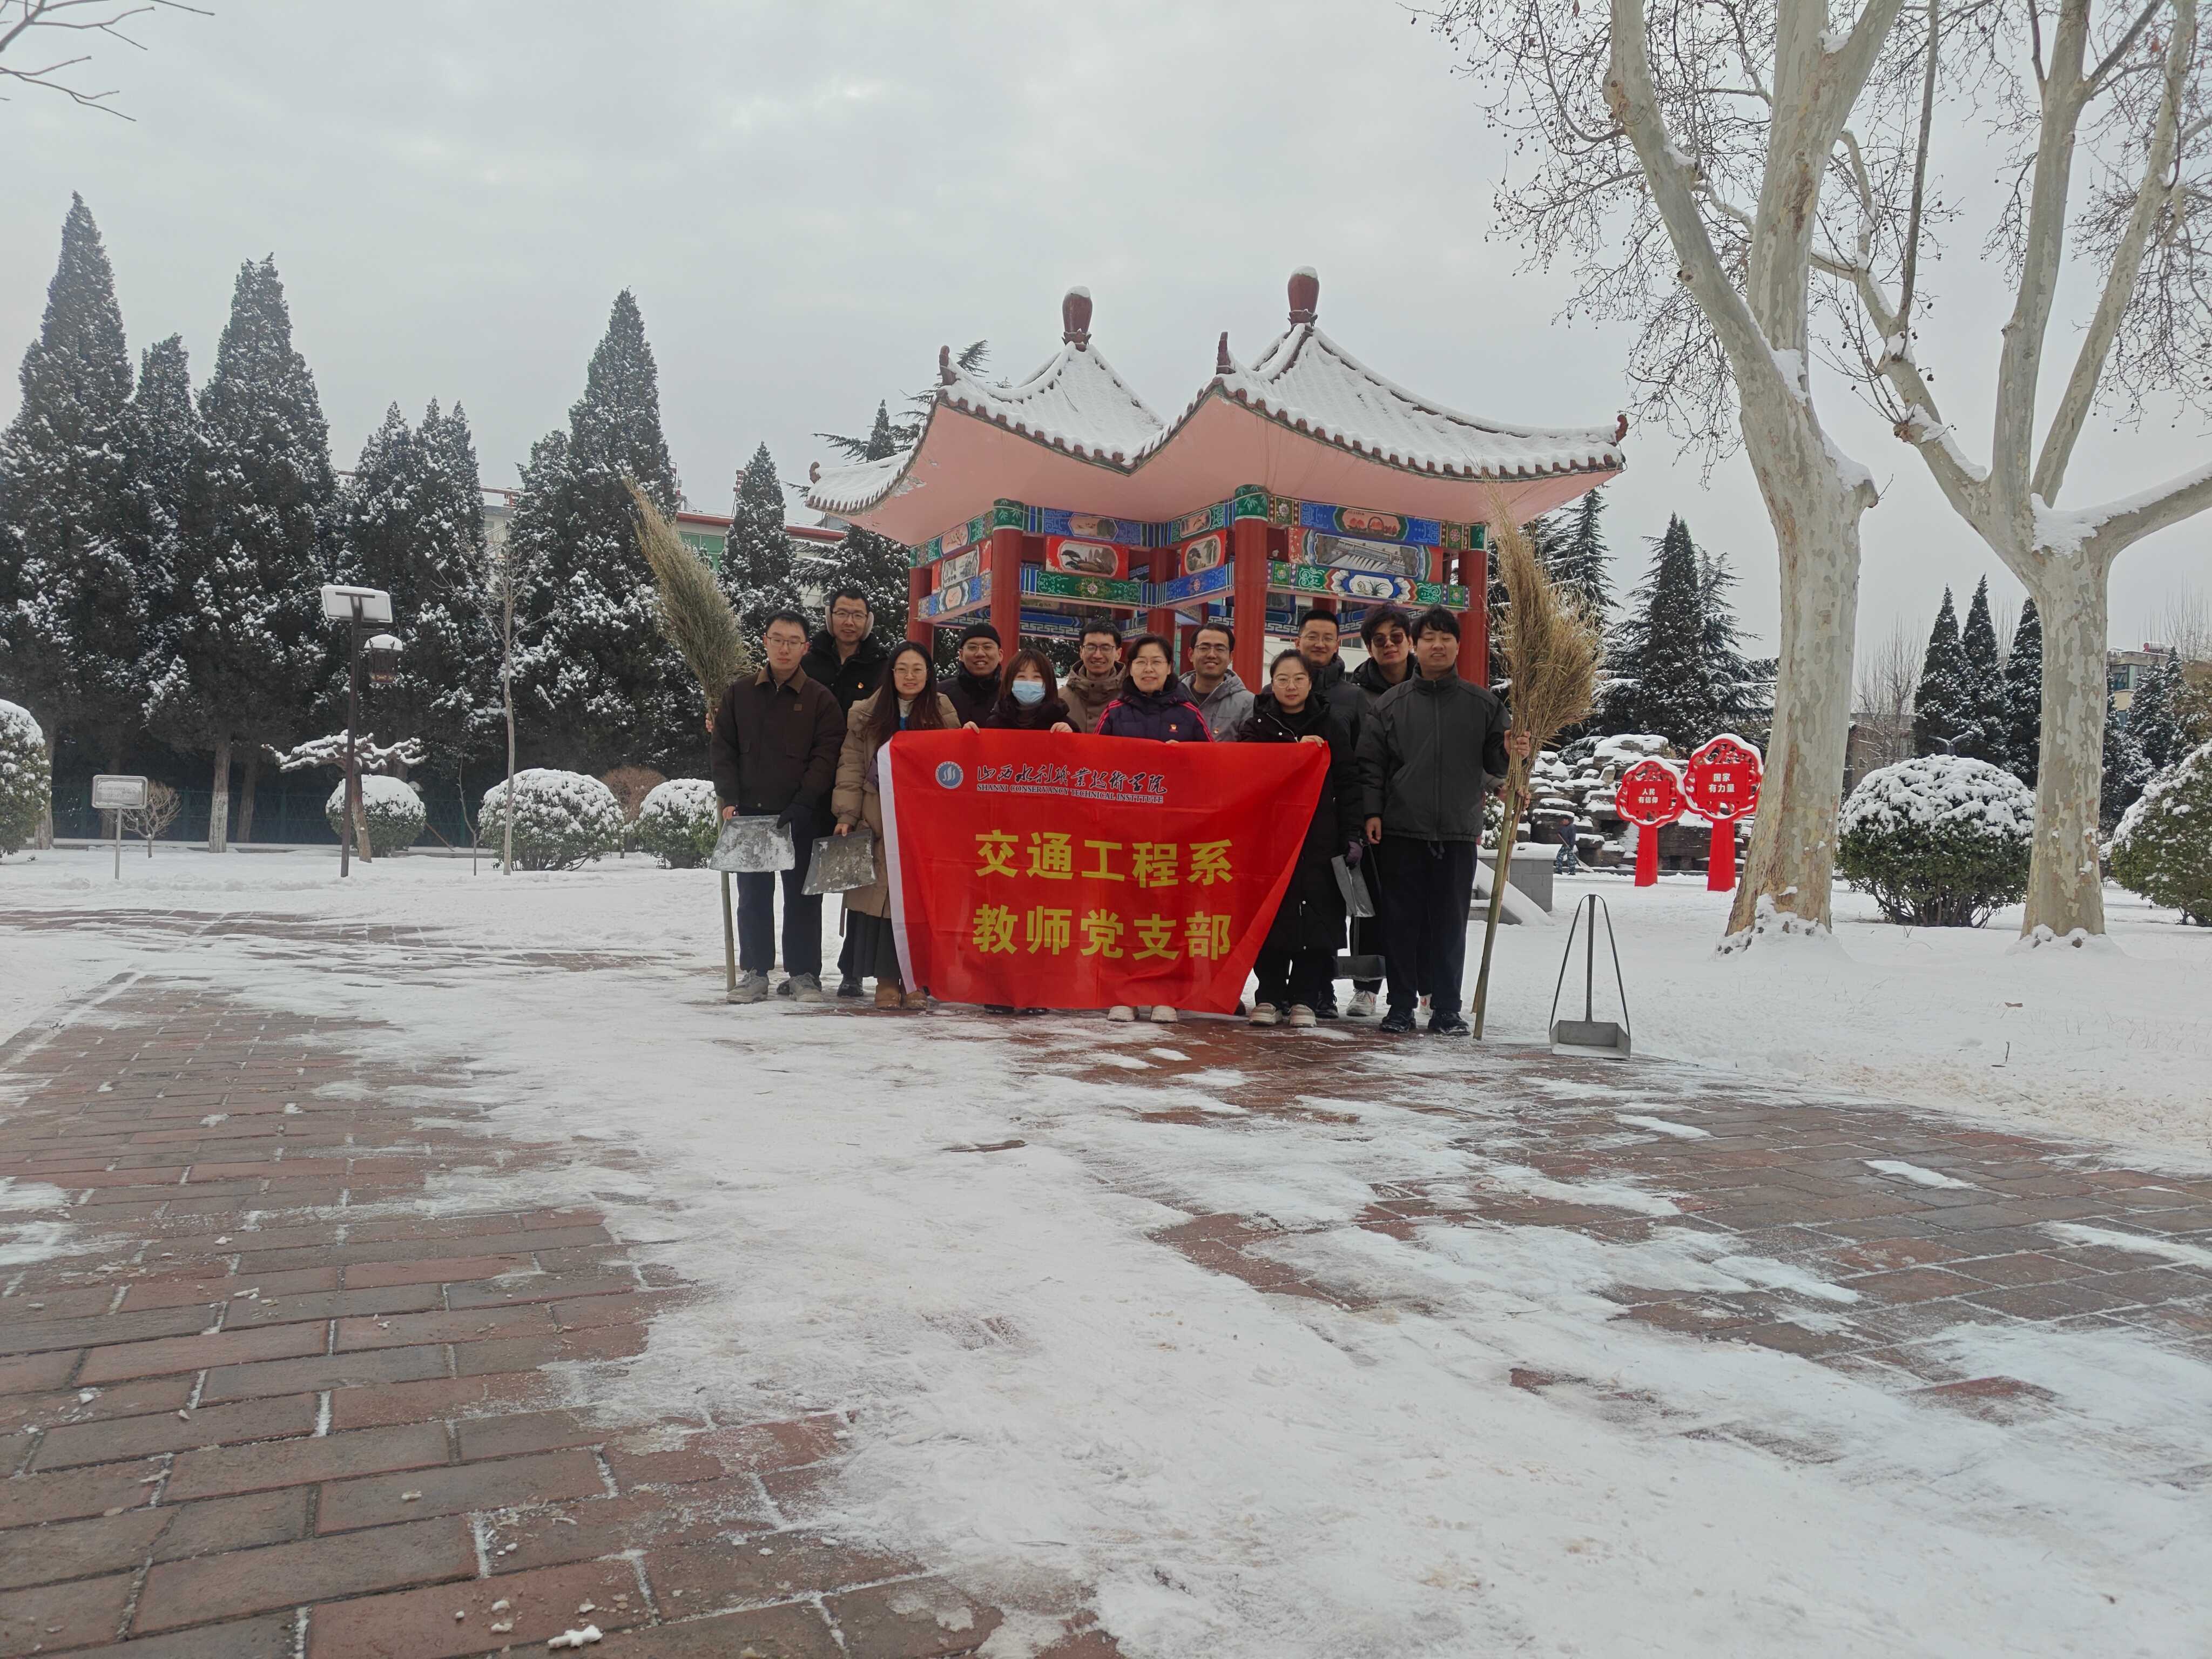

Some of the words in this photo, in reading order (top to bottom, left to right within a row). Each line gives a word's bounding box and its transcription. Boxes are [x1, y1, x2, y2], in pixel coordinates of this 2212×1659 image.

[1713, 773, 1730, 782] 国家
[977, 784, 1008, 792] SHANXI
[1010, 785, 1069, 795] CONSERVANCY
[1070, 788, 1115, 800] TECHNICAL
[1708, 784, 1735, 793] 有力量
[975, 830, 1233, 888] 交通工程系
[973, 903, 1232, 961] 教师党支部
